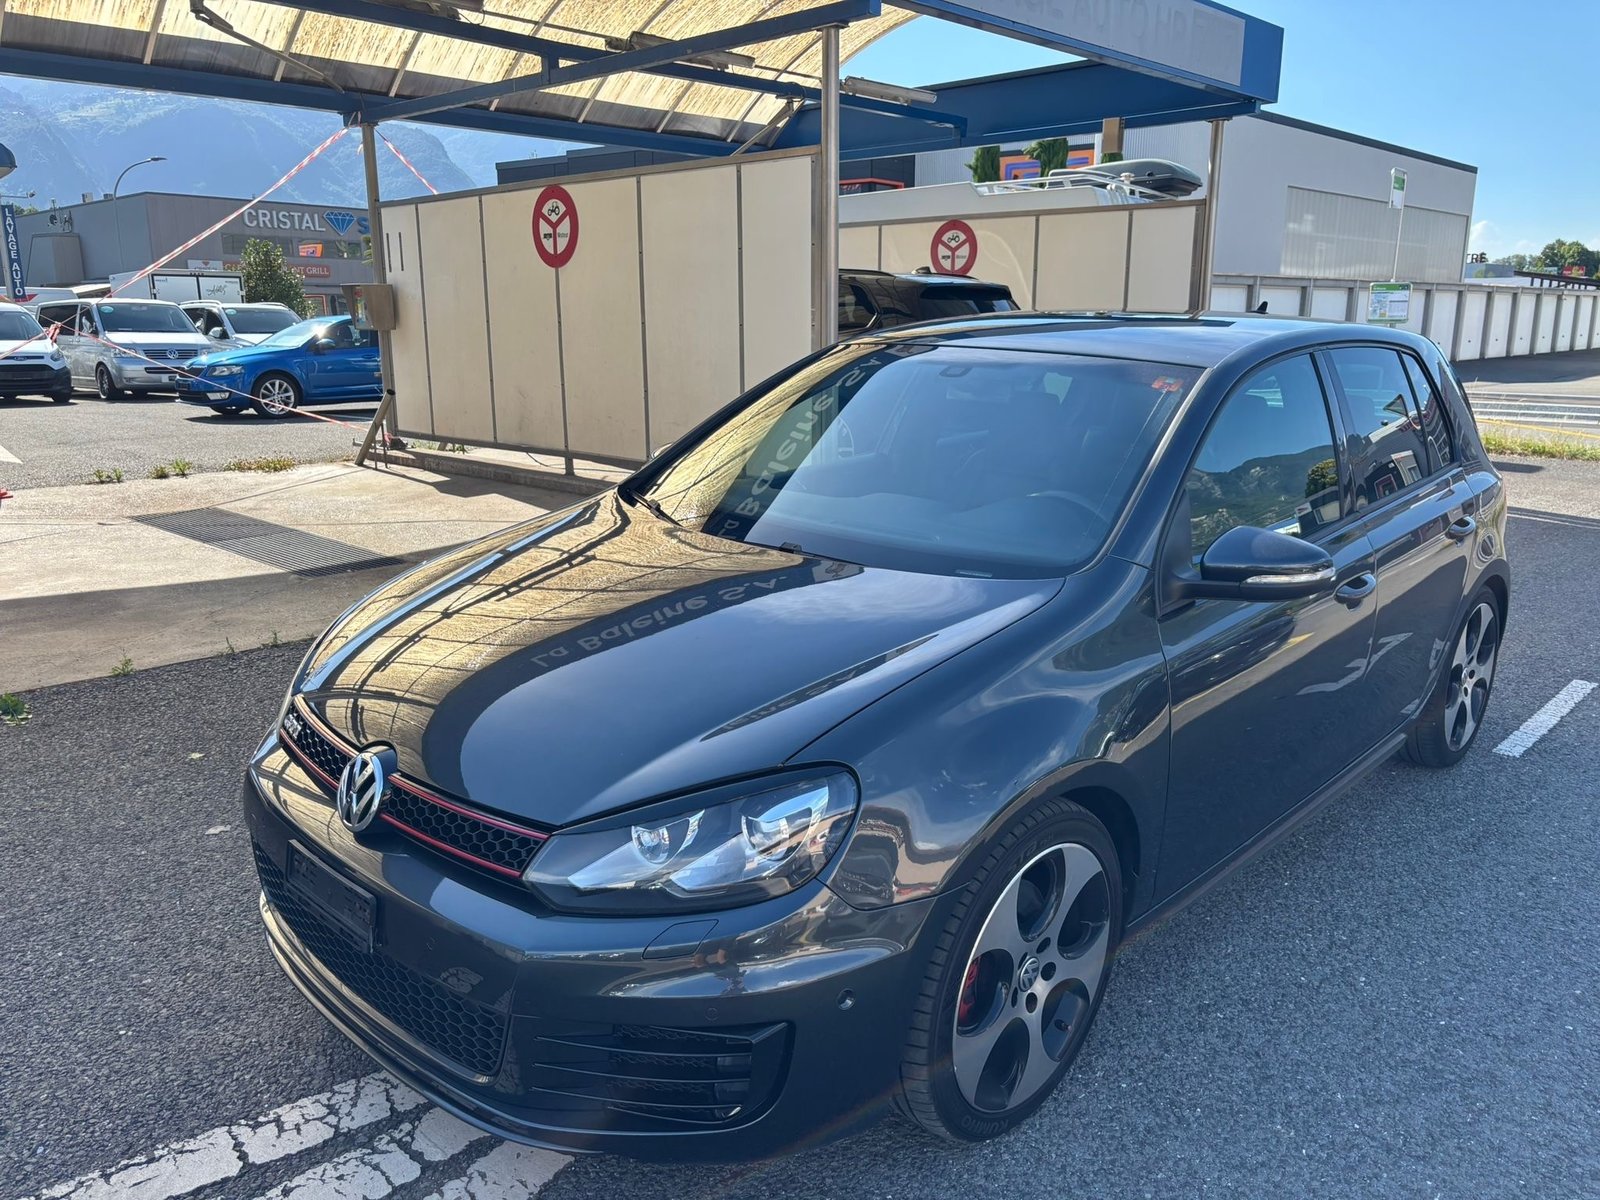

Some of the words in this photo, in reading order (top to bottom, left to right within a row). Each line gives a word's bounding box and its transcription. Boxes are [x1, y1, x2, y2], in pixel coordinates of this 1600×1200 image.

[243, 209, 325, 231] CRISTAL
[5, 208, 18, 259] LAVAGE
[12, 263, 23, 295] AUTO
[306, 266, 329, 275] GRILL
